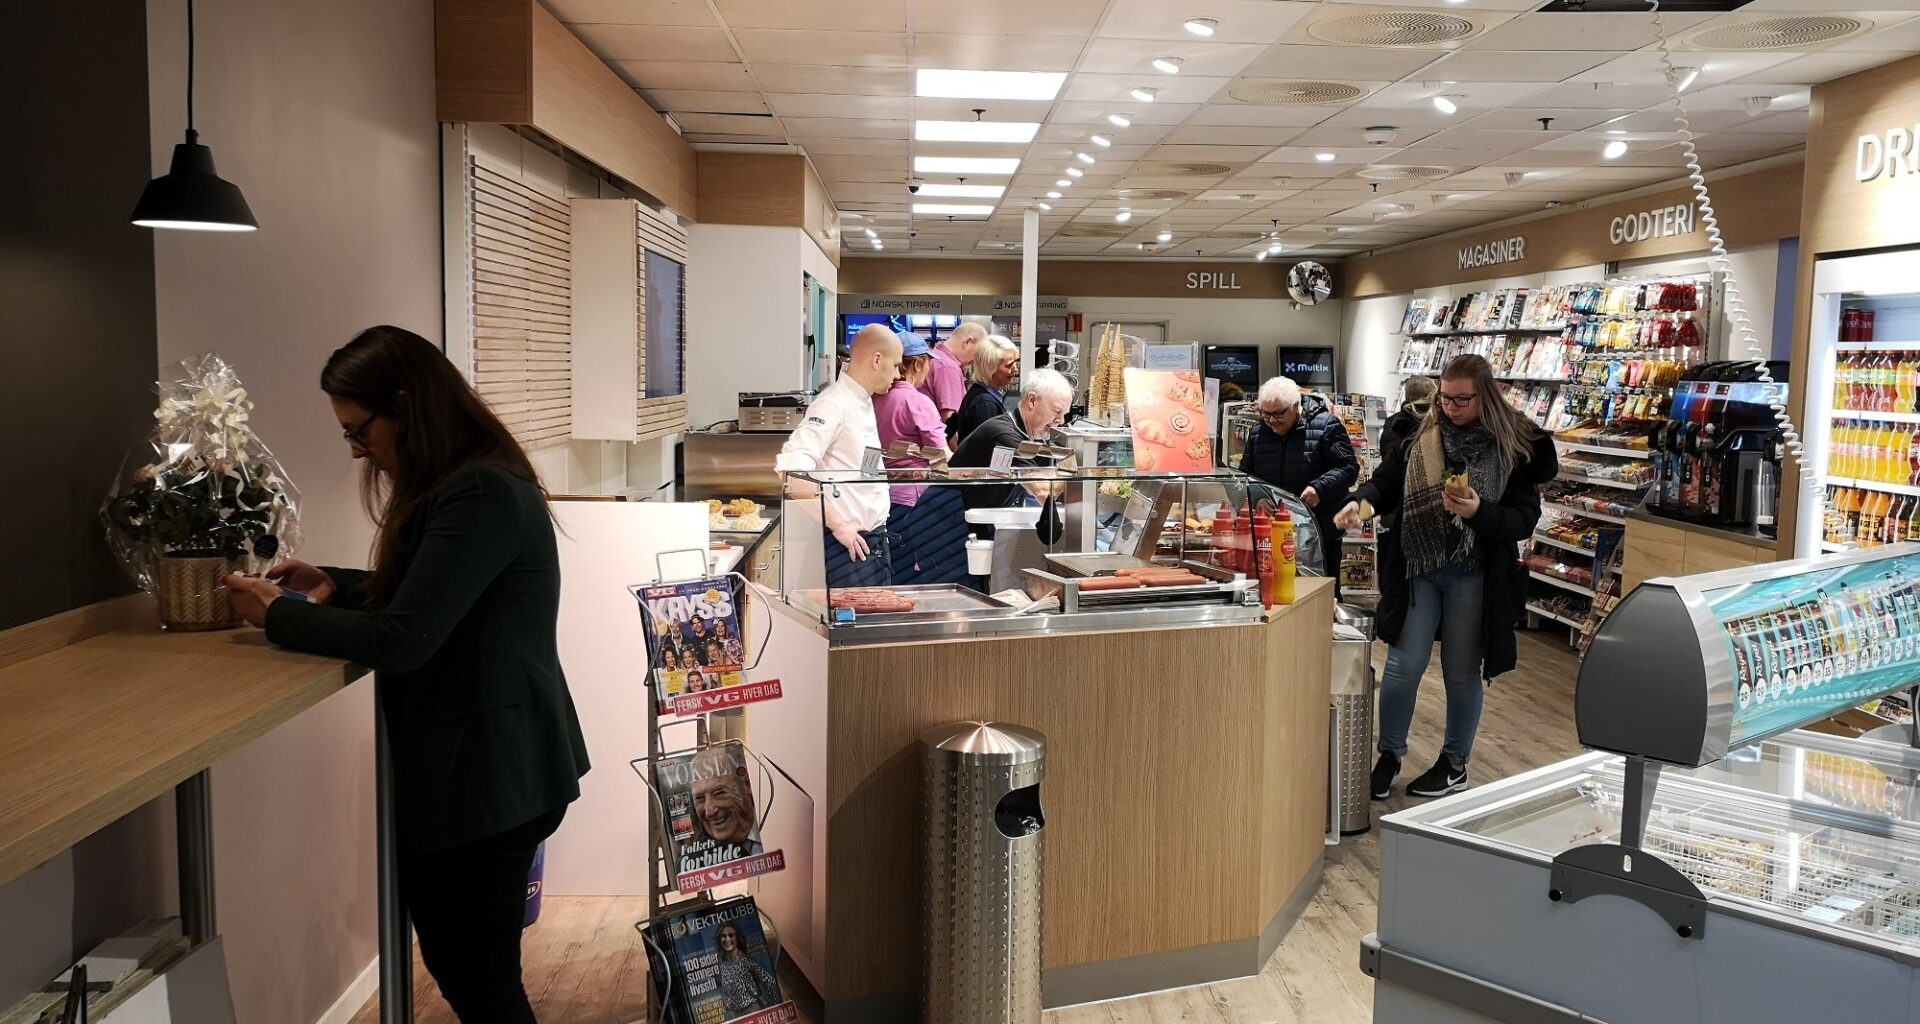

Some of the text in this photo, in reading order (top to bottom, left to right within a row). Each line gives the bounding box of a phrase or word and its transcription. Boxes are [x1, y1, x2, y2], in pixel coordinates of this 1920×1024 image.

[1609, 202, 1697, 245] GODTERI
[1458, 236, 1525, 270] MAGASINER
[1186, 272, 1241, 289] SPILL
[871, 300, 941, 309] NORSK TIPPING
[1297, 362, 1330, 372] Multix
[649, 591, 732, 634] KRYSS
[1735, 647, 1747, 681] Royal
[1751, 640, 1764, 677] Royal
[677, 696, 704, 712] FERSK
[705, 691, 740, 705] VG
[743, 686, 764, 700] HVER
[764, 683, 780, 696] DAG
[679, 844, 742, 873] forbilde
[681, 839, 716, 856] Folkets
[680, 854, 782, 891] FERSK VG HVER DAG
[687, 903, 755, 932] VEKTKLUBB
[684, 959, 700, 972] 100
[700, 953, 719, 968] sider
[687, 964, 720, 984] sunnere
[689, 978, 717, 997] livsstil
[779, 1006, 795, 1021] DAG
